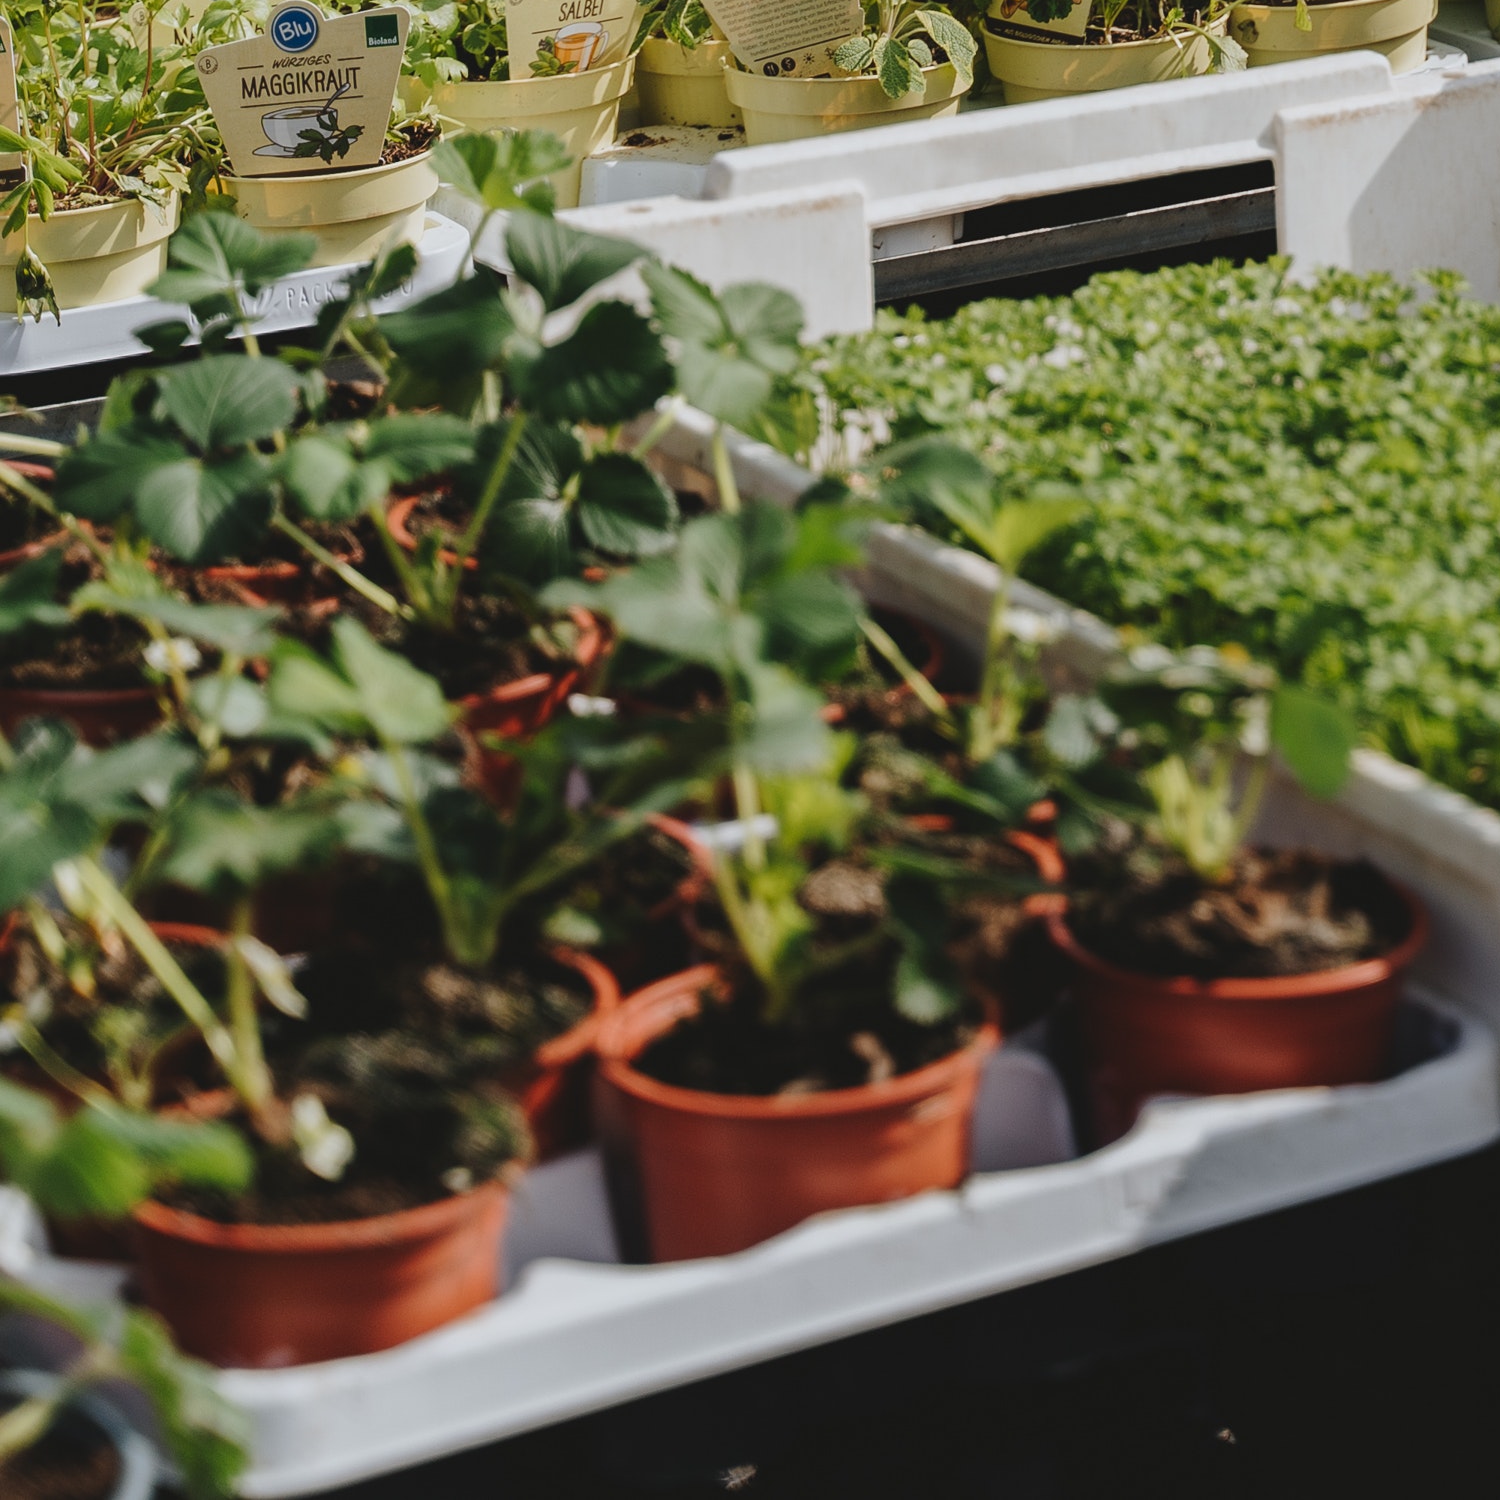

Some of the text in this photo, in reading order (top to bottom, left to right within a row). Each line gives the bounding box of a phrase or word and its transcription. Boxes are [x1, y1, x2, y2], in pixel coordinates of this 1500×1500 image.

[279, 21, 312, 42] Blu
[367, 36, 398, 46] Bioland
[241, 67, 361, 100] MAGGIKRAUT
